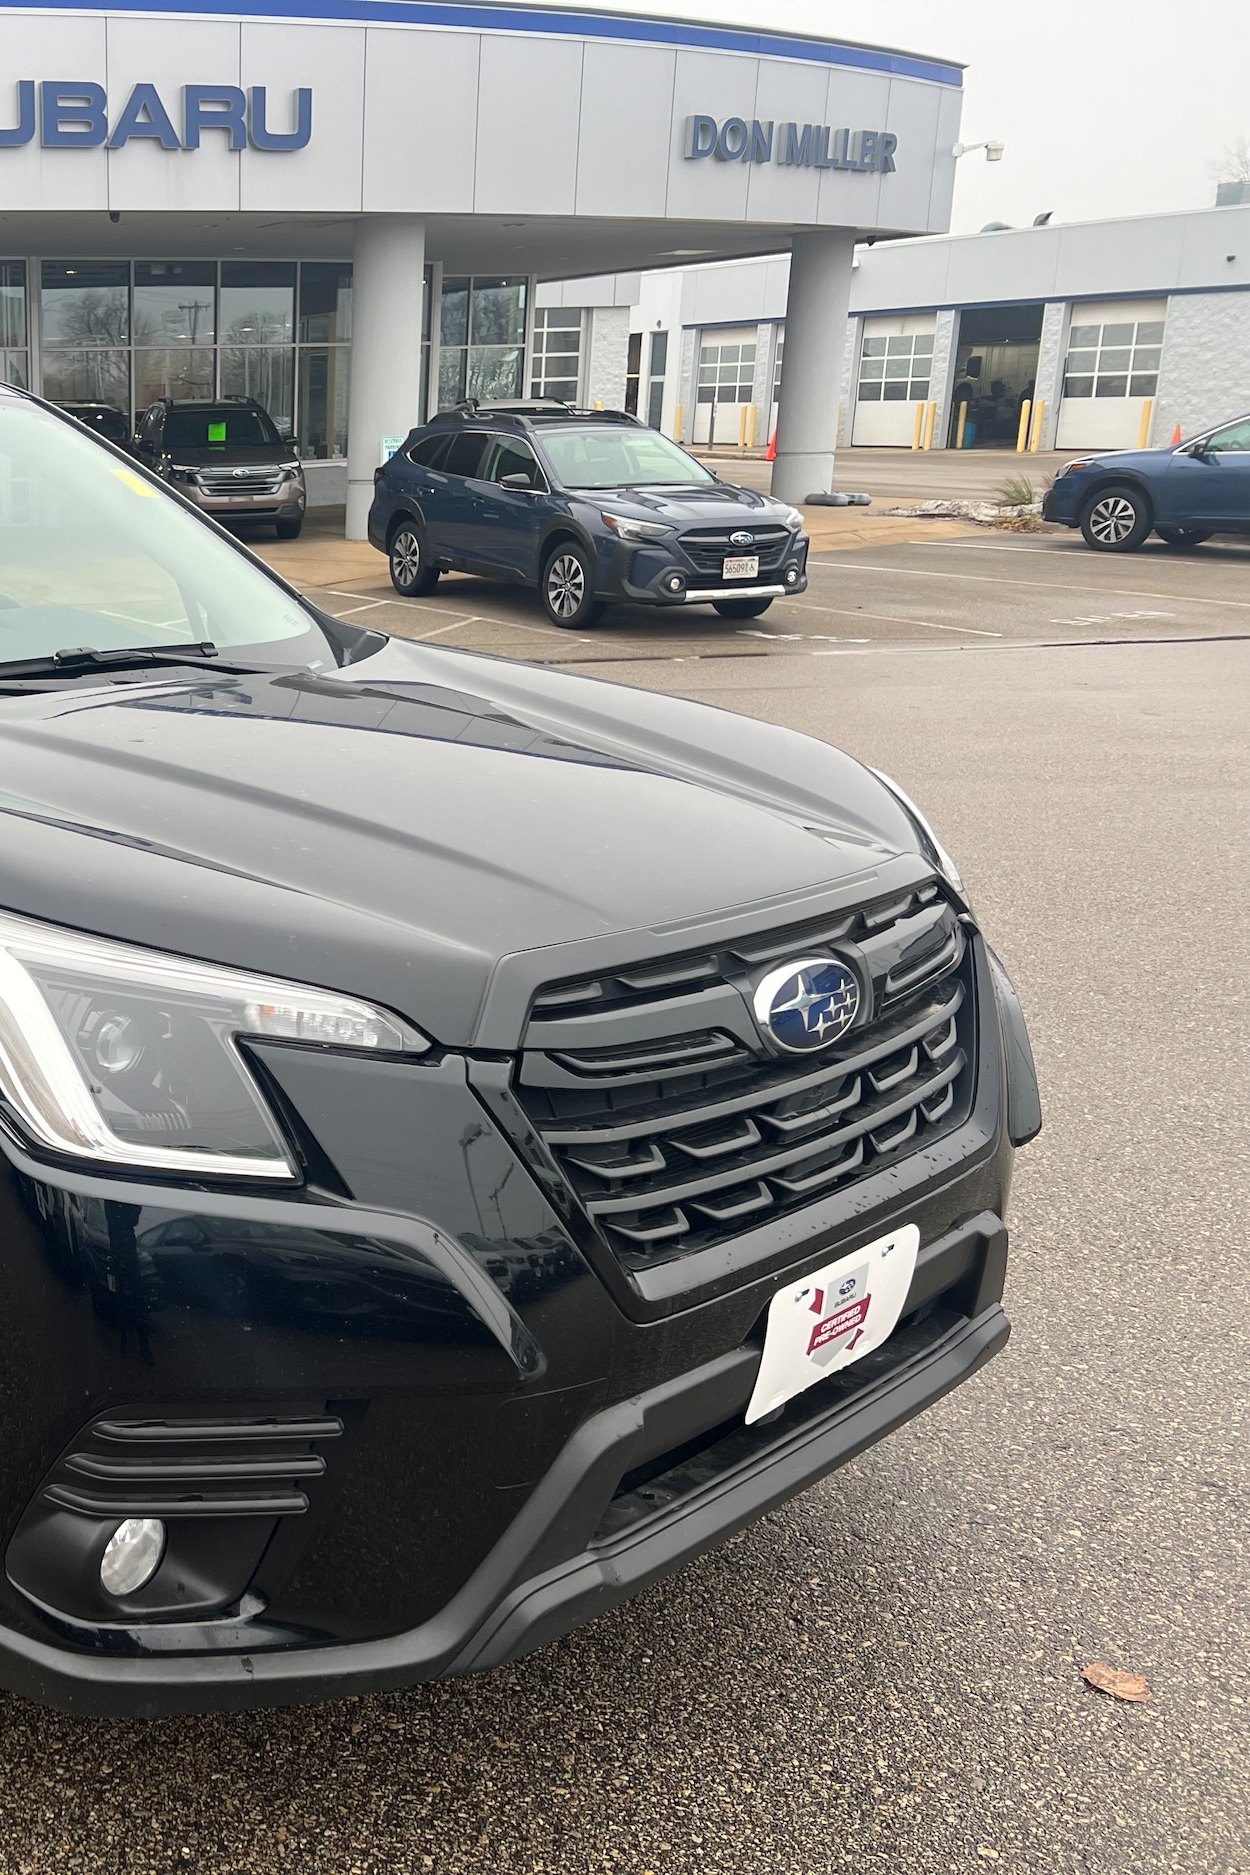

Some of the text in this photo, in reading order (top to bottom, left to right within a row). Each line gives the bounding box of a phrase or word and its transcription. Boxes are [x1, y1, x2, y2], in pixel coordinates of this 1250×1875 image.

[684, 114, 898, 173] DON MILLER
[834, 1292, 856, 1308] SUBARU
[813, 1314, 862, 1346] PRE-OWNED
[820, 1305, 861, 1333] CERTIFIED
